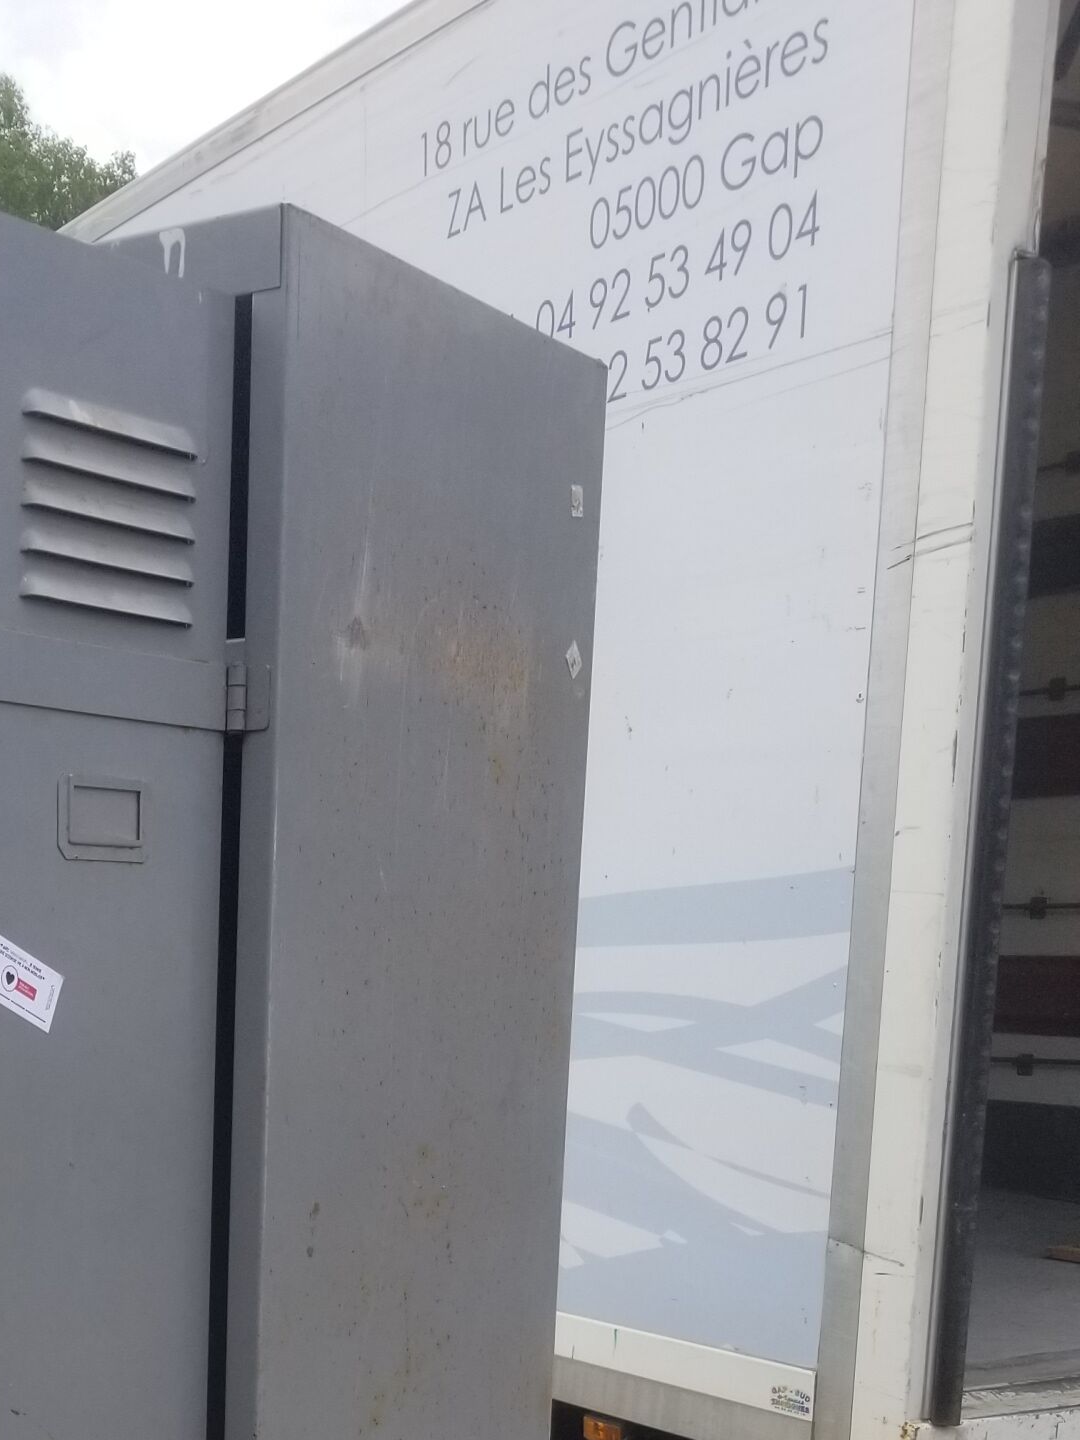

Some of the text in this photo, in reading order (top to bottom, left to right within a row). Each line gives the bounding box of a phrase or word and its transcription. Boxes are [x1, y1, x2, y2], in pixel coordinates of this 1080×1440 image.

[420, 120, 452, 177] 18
[463, 99, 516, 157] rue
[528, 56, 592, 119] des
[446, 18, 829, 240] ZA Les Eyssagnières
[589, 115, 824, 250] 05000 Gap
[536, 189, 821, 339] 04 92 53 49 04
[641, 329, 686, 391] 53
[700, 306, 749, 371] 82
[765, 283, 808, 350] 91
